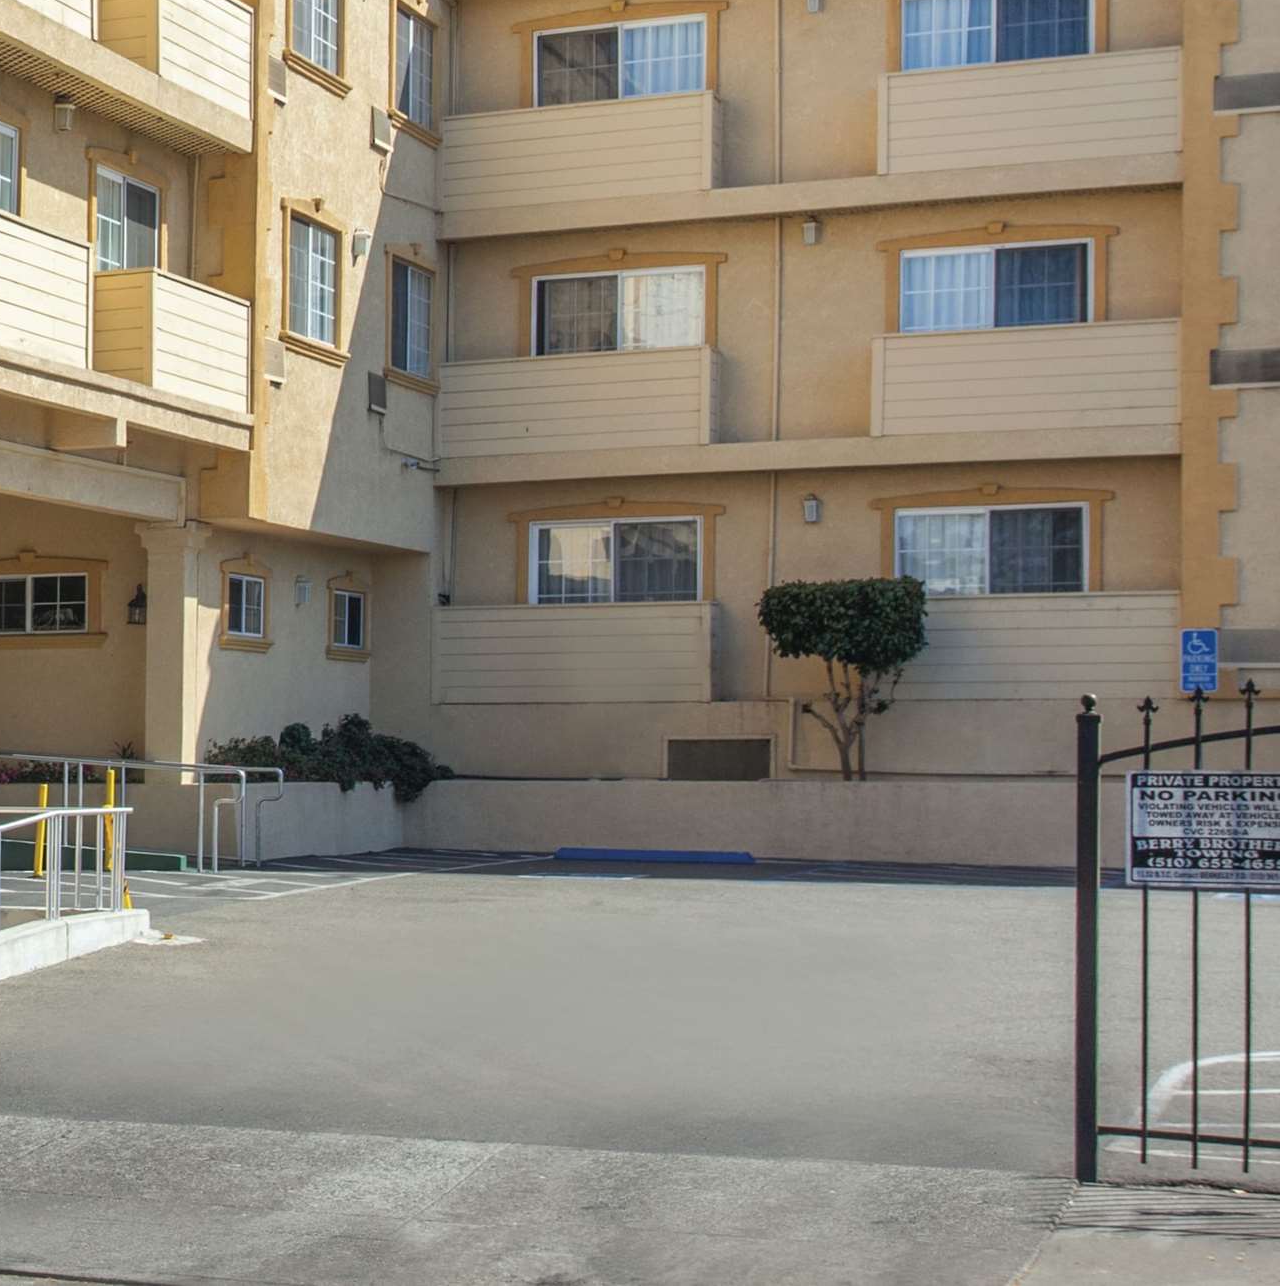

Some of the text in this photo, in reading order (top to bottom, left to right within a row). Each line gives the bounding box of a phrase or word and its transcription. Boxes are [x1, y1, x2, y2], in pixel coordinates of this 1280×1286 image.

[1137, 775, 1204, 786] PRIVATE
[1140, 790, 1280, 801] NO PARKIN
[1197, 803, 1250, 811] VEHICLES
[1136, 839, 1194, 850] BERRY
[1174, 849, 1259, 858] TOWING
[1147, 857, 1192, 867] (510)
